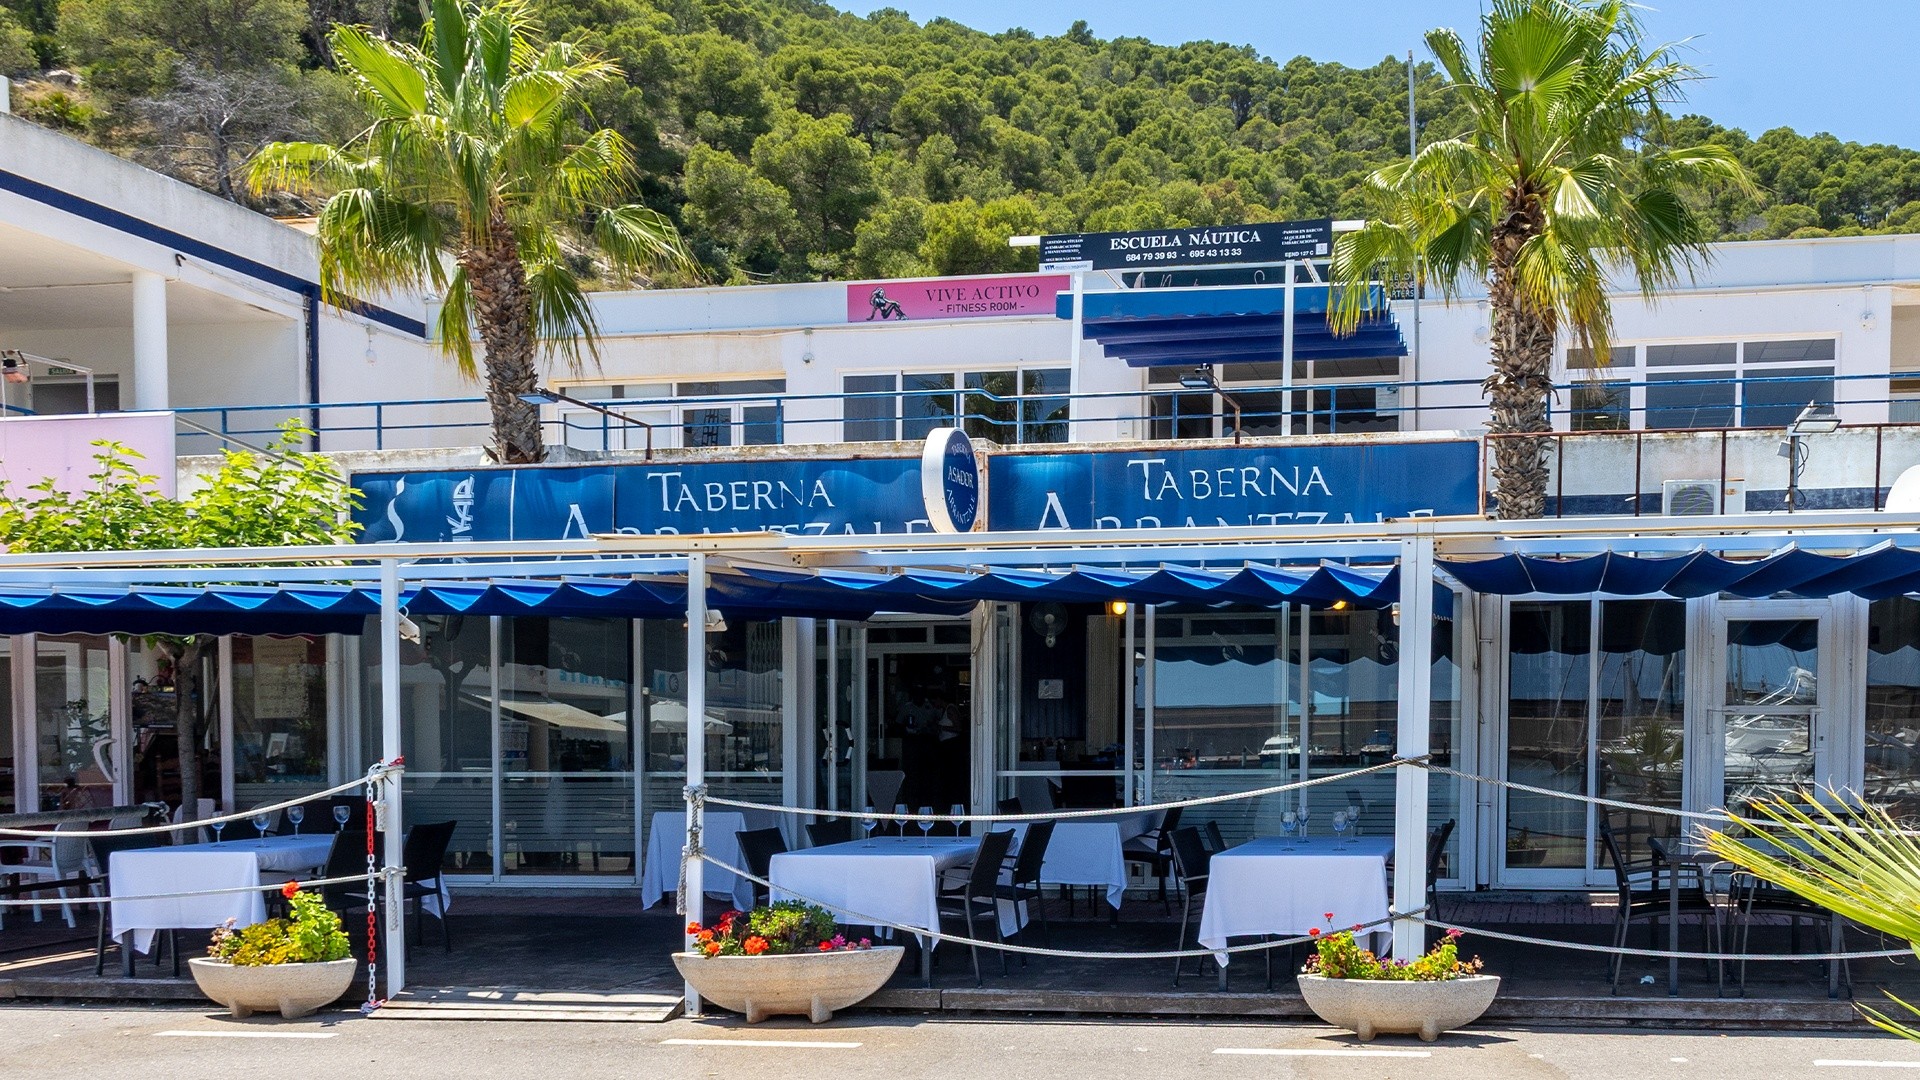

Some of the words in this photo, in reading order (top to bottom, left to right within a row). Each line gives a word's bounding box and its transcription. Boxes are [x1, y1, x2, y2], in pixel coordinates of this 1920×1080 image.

[1110, 235, 1182, 250] ESCUELA
[1188, 229, 1261, 246] NÁUTICA
[1126, 253, 1140, 262] 684
[1143, 252, 1153, 261] 79
[1155, 252, 1165, 260] 39
[1166, 251, 1177, 259] 93
[1190, 250, 1204, 258] 695
[1207, 249, 1217, 257] 43
[1220, 248, 1229, 256] 13
[1231, 248, 1241, 256] 33
[926, 287, 966, 302] VIVE
[971, 284, 1039, 301] ACTIVO
[946, 303, 986, 313] FITNESS
[991, 302, 1017, 311] ROOM
[948, 466, 974, 489] ASADOR
[1127, 458, 1332, 500] TABERNA
[647, 471, 835, 512] TABERNA
